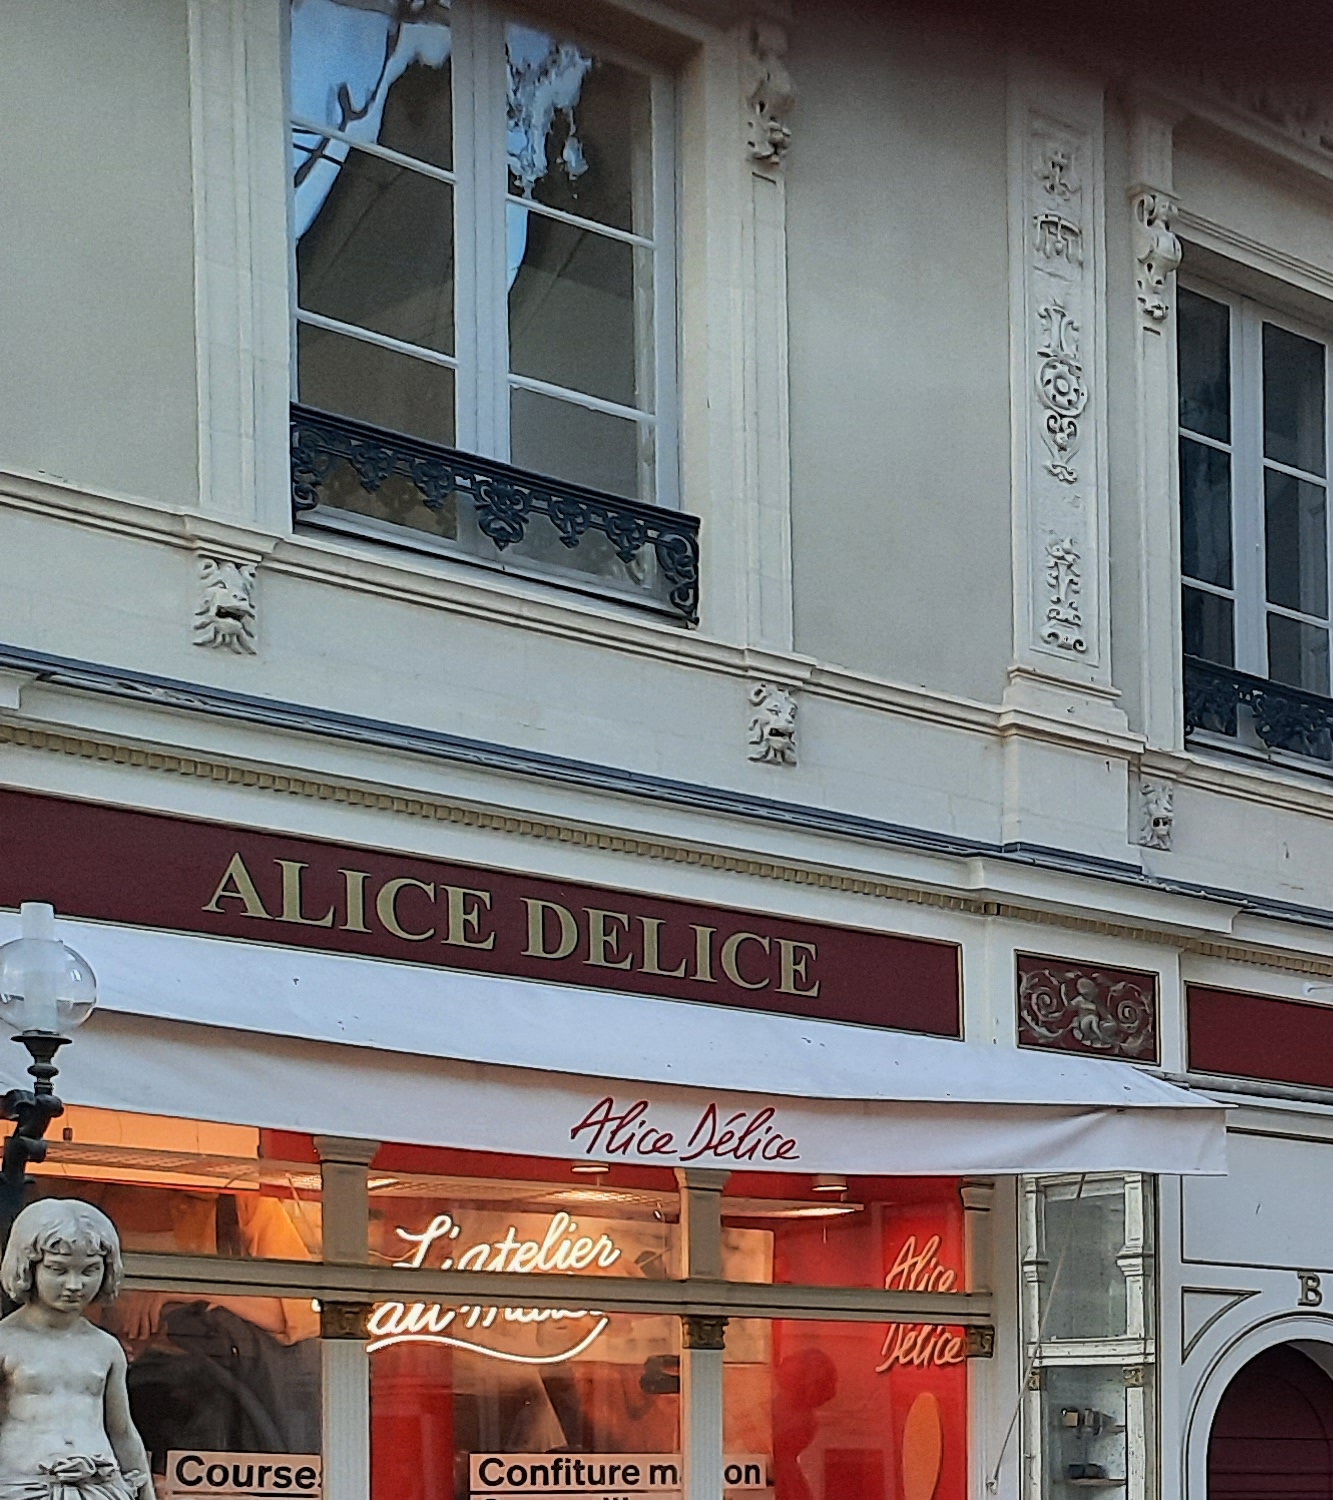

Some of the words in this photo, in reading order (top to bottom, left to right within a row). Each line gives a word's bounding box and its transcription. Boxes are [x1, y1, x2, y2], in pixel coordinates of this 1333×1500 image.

[202, 852, 495, 949] ALICE
[520, 897, 821, 997] DELICE
[570, 1097, 678, 1155] Alice
[680, 1102, 800, 1162] Délice
[885, 1235, 957, 1293] Alice
[1297, 1271, 1322, 1306] B
[175, 1455, 322, 1489] Course
[479, 1457, 640, 1487] Confiture
